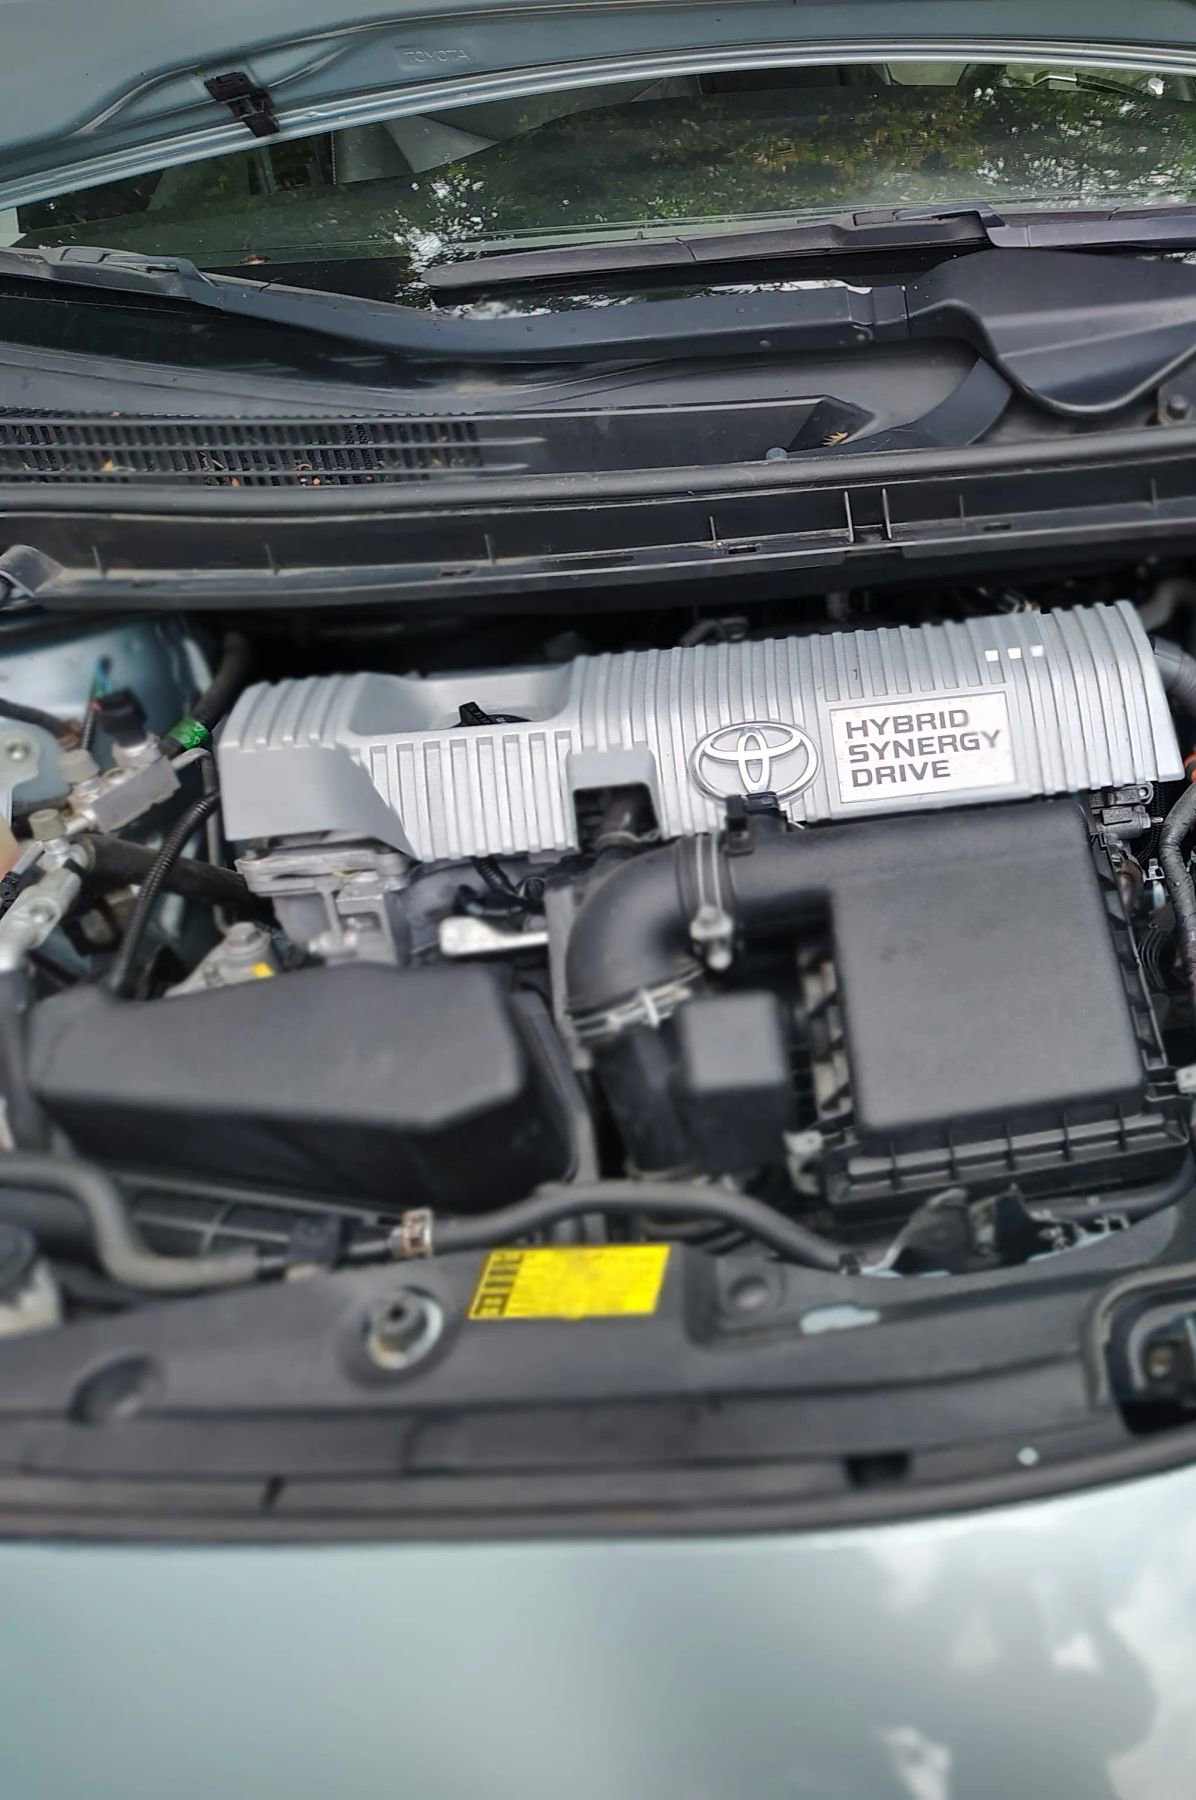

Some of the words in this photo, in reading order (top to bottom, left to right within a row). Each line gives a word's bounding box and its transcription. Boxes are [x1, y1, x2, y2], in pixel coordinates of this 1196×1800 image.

[403, 49, 471, 63] TOYOTA
[846, 710, 969, 739] HYBRID
[849, 730, 1001, 763] SYNERGY
[852, 760, 951, 788] DRIVE
